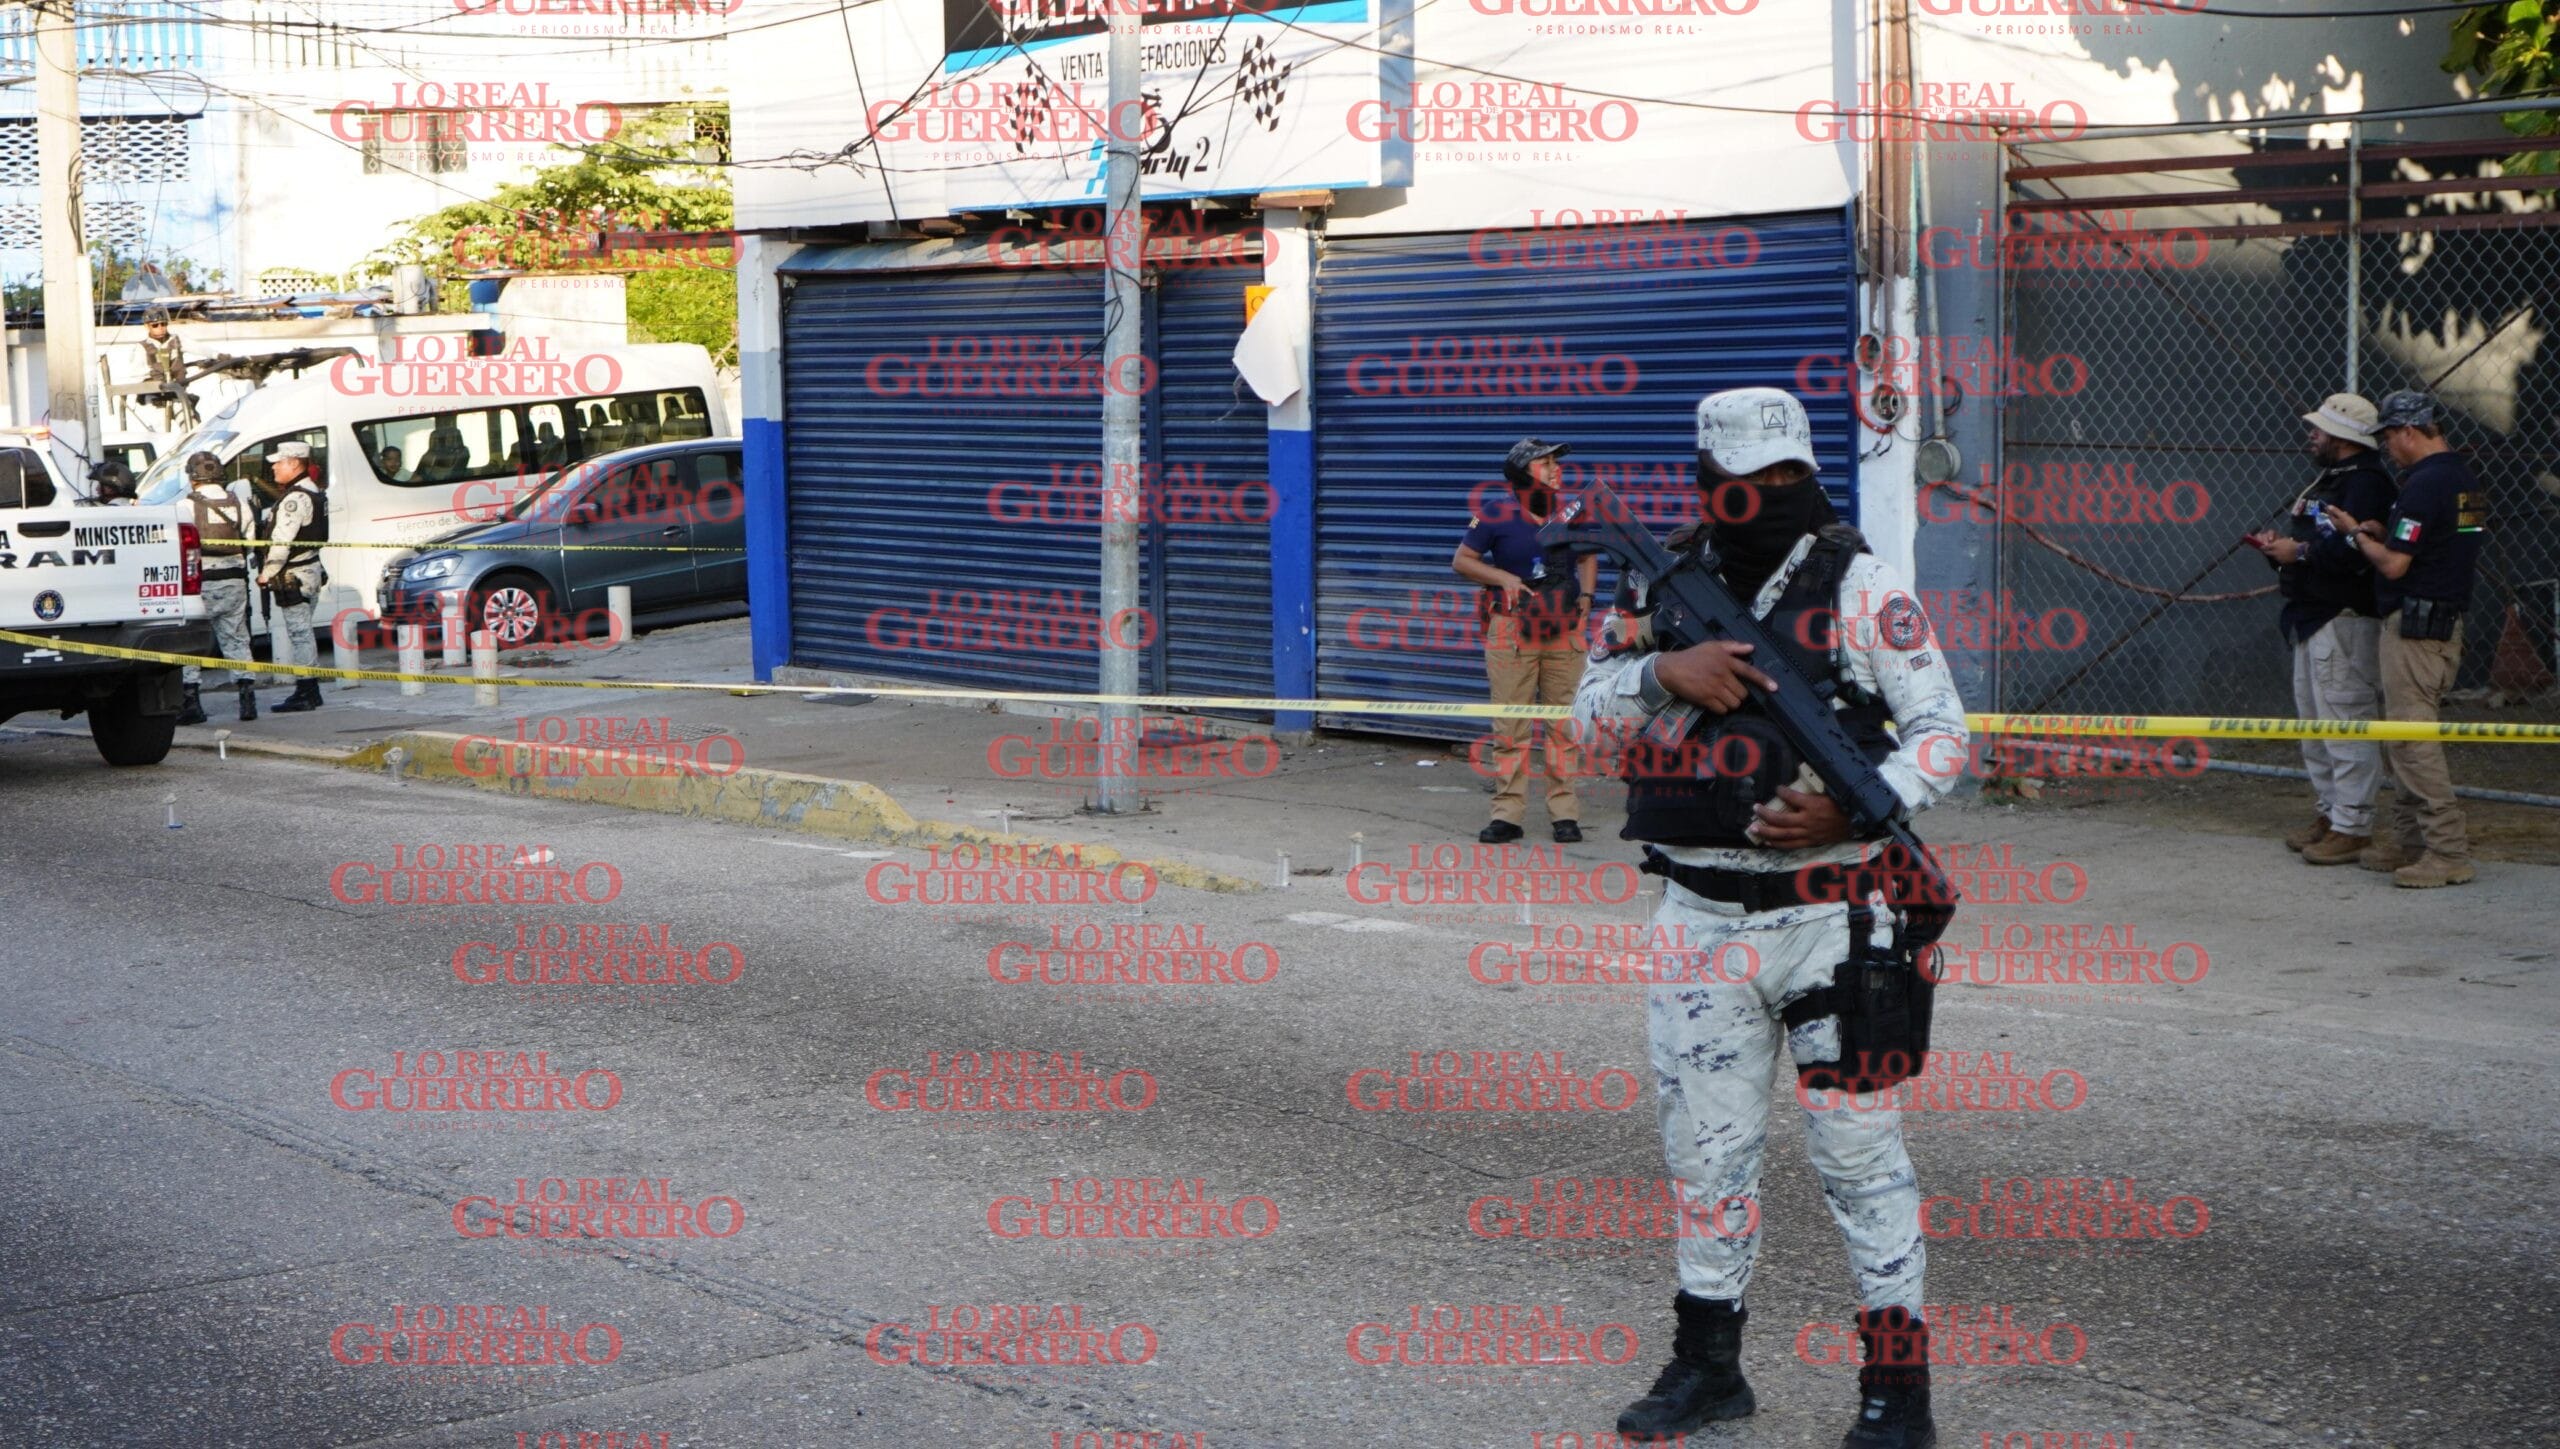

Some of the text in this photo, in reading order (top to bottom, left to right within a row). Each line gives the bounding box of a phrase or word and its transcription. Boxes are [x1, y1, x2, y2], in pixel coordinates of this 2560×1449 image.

[1061, 38, 1226, 81] VENTA EFACCIONES
[1141, 136, 1210, 181] arly 2
[144, 565, 179, 582] PM-377
[141, 585, 175, 596] 911
